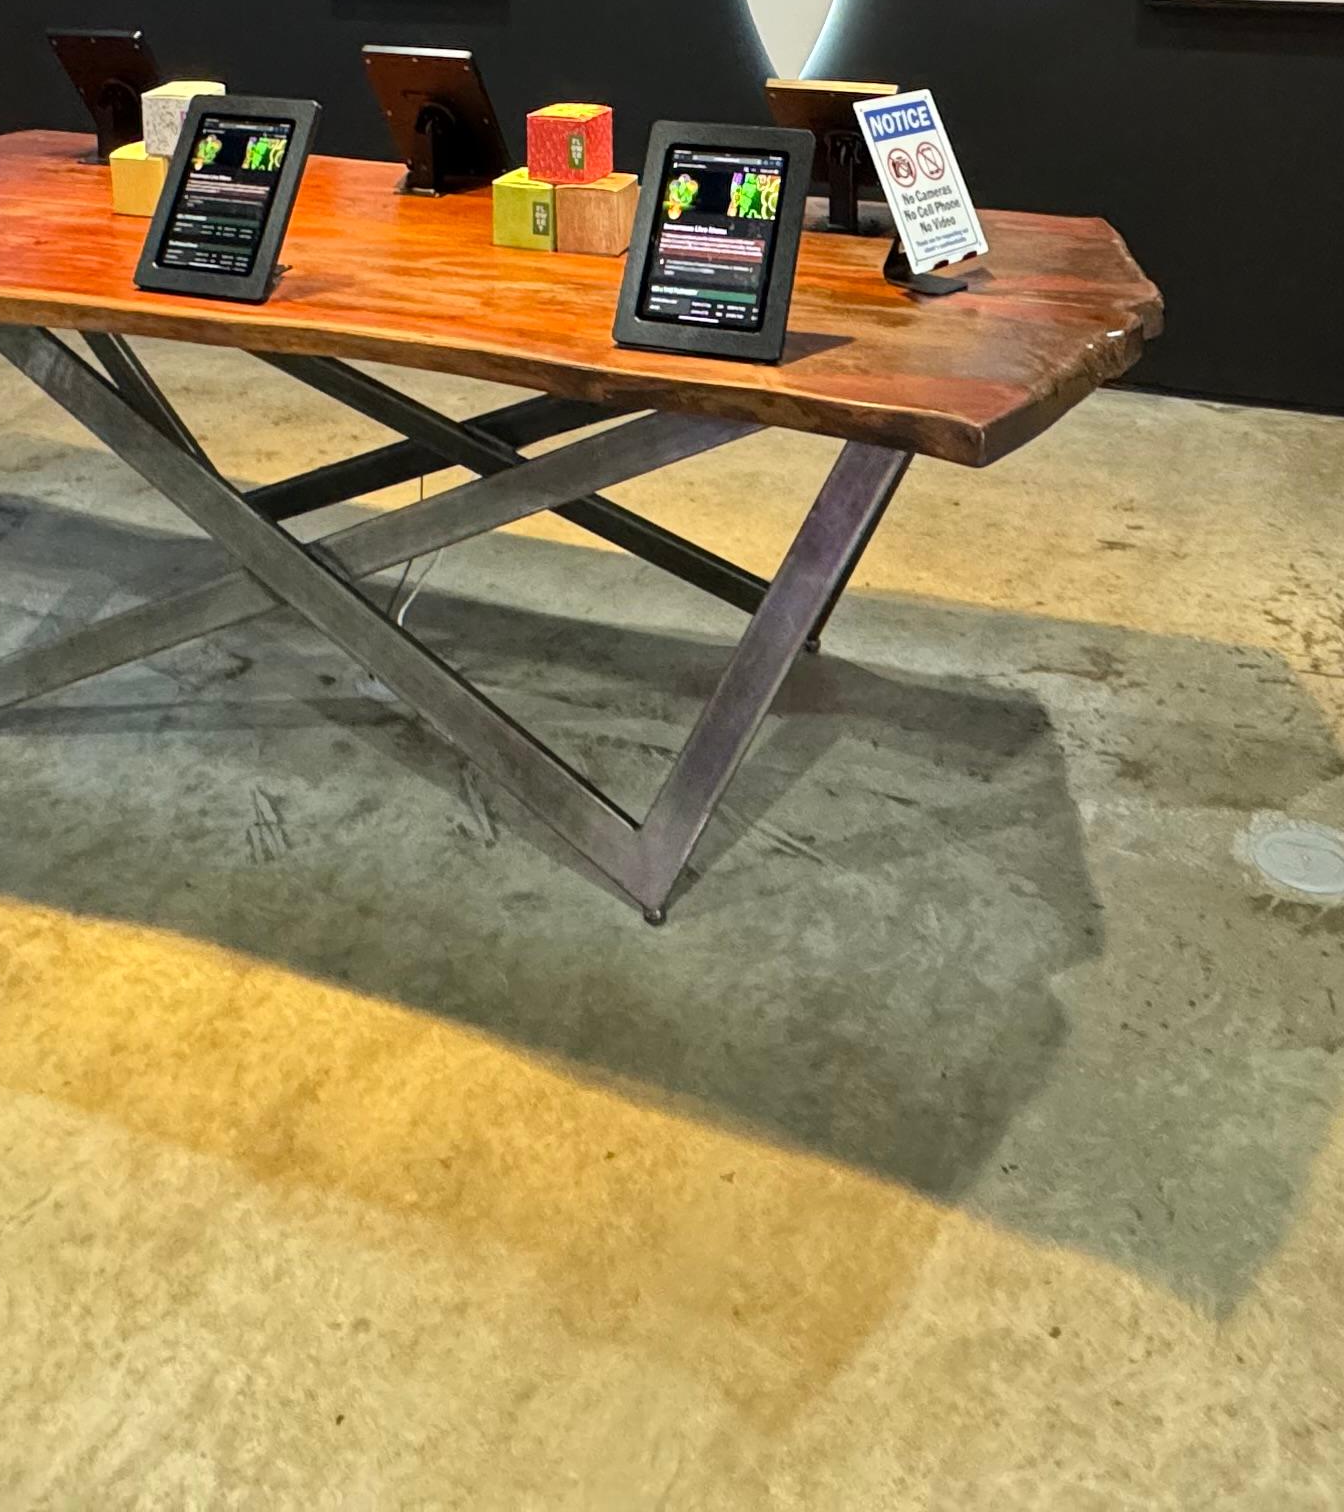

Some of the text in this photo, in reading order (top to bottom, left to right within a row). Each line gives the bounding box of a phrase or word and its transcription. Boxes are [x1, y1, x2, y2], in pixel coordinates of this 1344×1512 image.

[869, 105, 931, 137] NOTICE
[901, 185, 953, 205] No Cameras
[903, 199, 961, 222] No Cell Phone
[919, 216, 956, 234] No Video
